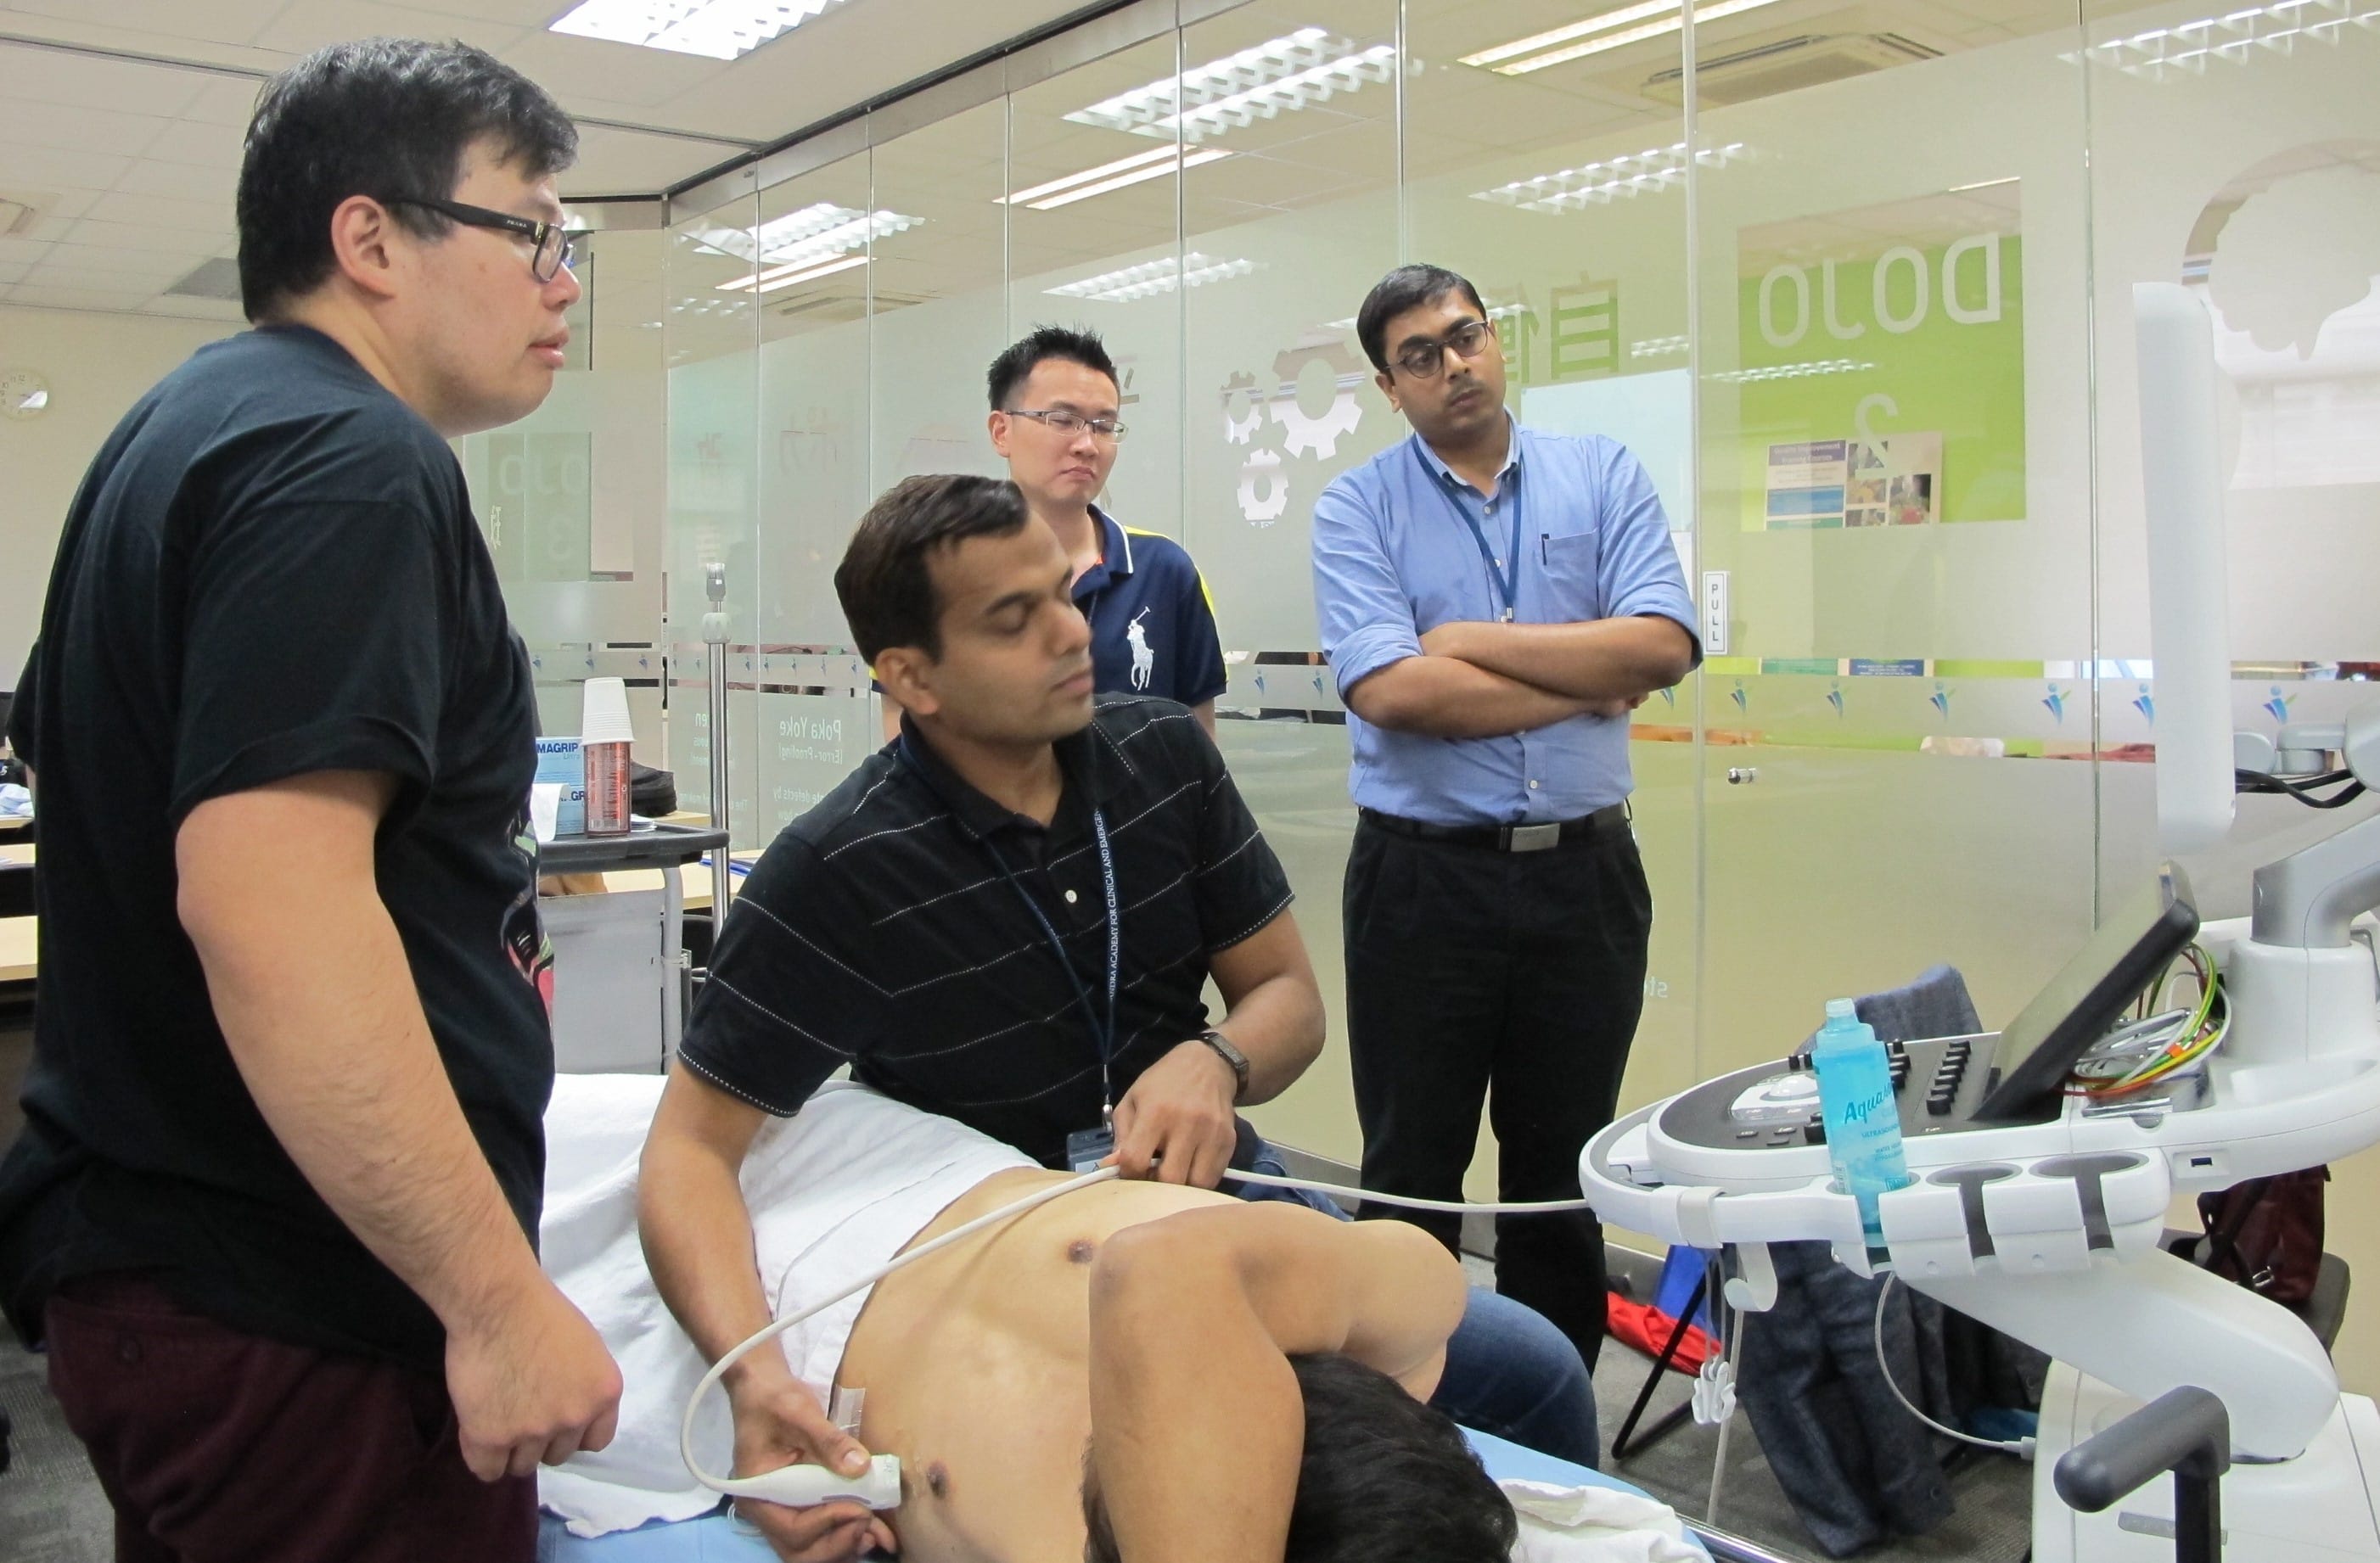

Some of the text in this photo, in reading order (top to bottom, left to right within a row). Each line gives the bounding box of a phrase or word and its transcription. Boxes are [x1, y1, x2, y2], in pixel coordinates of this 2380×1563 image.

[1102, 849, 1111, 867] AND
[1104, 869, 1117, 908] CLINICAL
[1109, 908, 1118, 925] FOR
[1110, 927, 1119, 968] ACADEMY
